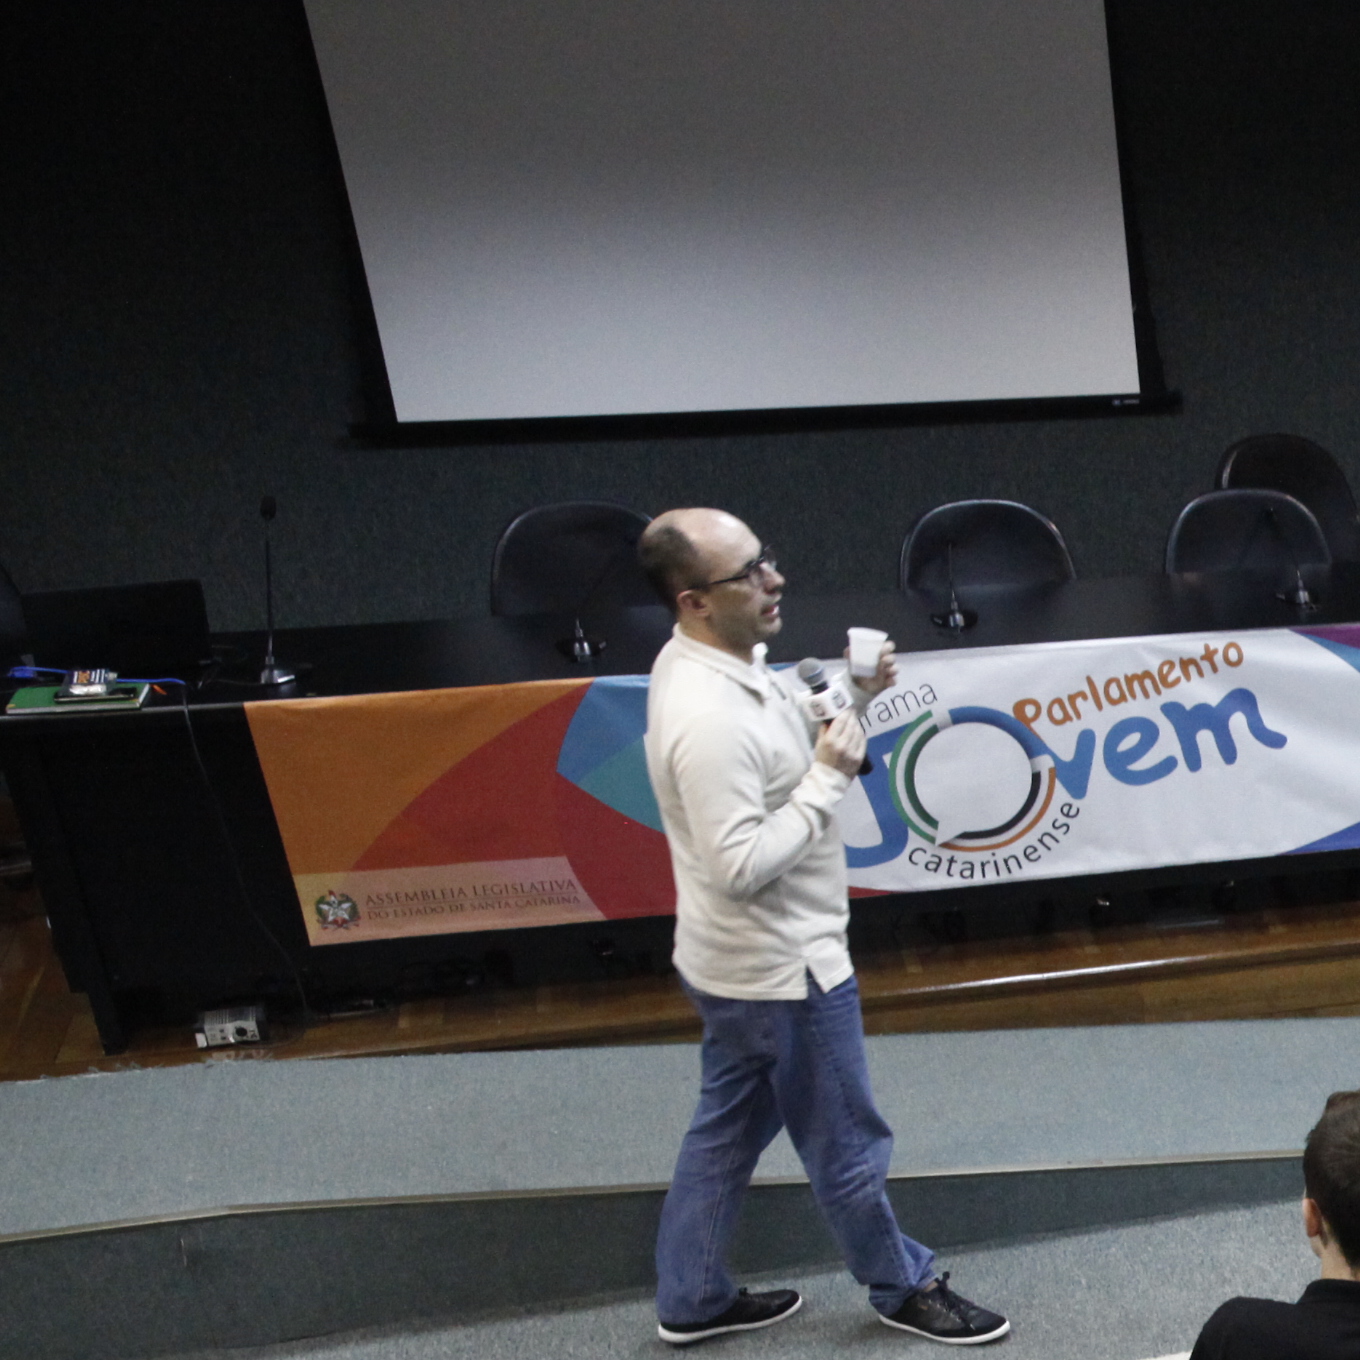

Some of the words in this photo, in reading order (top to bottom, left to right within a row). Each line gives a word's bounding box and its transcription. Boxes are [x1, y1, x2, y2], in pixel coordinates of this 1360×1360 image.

[1012, 641, 1244, 737] Parlamento
[366, 887, 467, 907] ASSEMBLEIA
[473, 878, 578, 899] LEGISLATIVA
